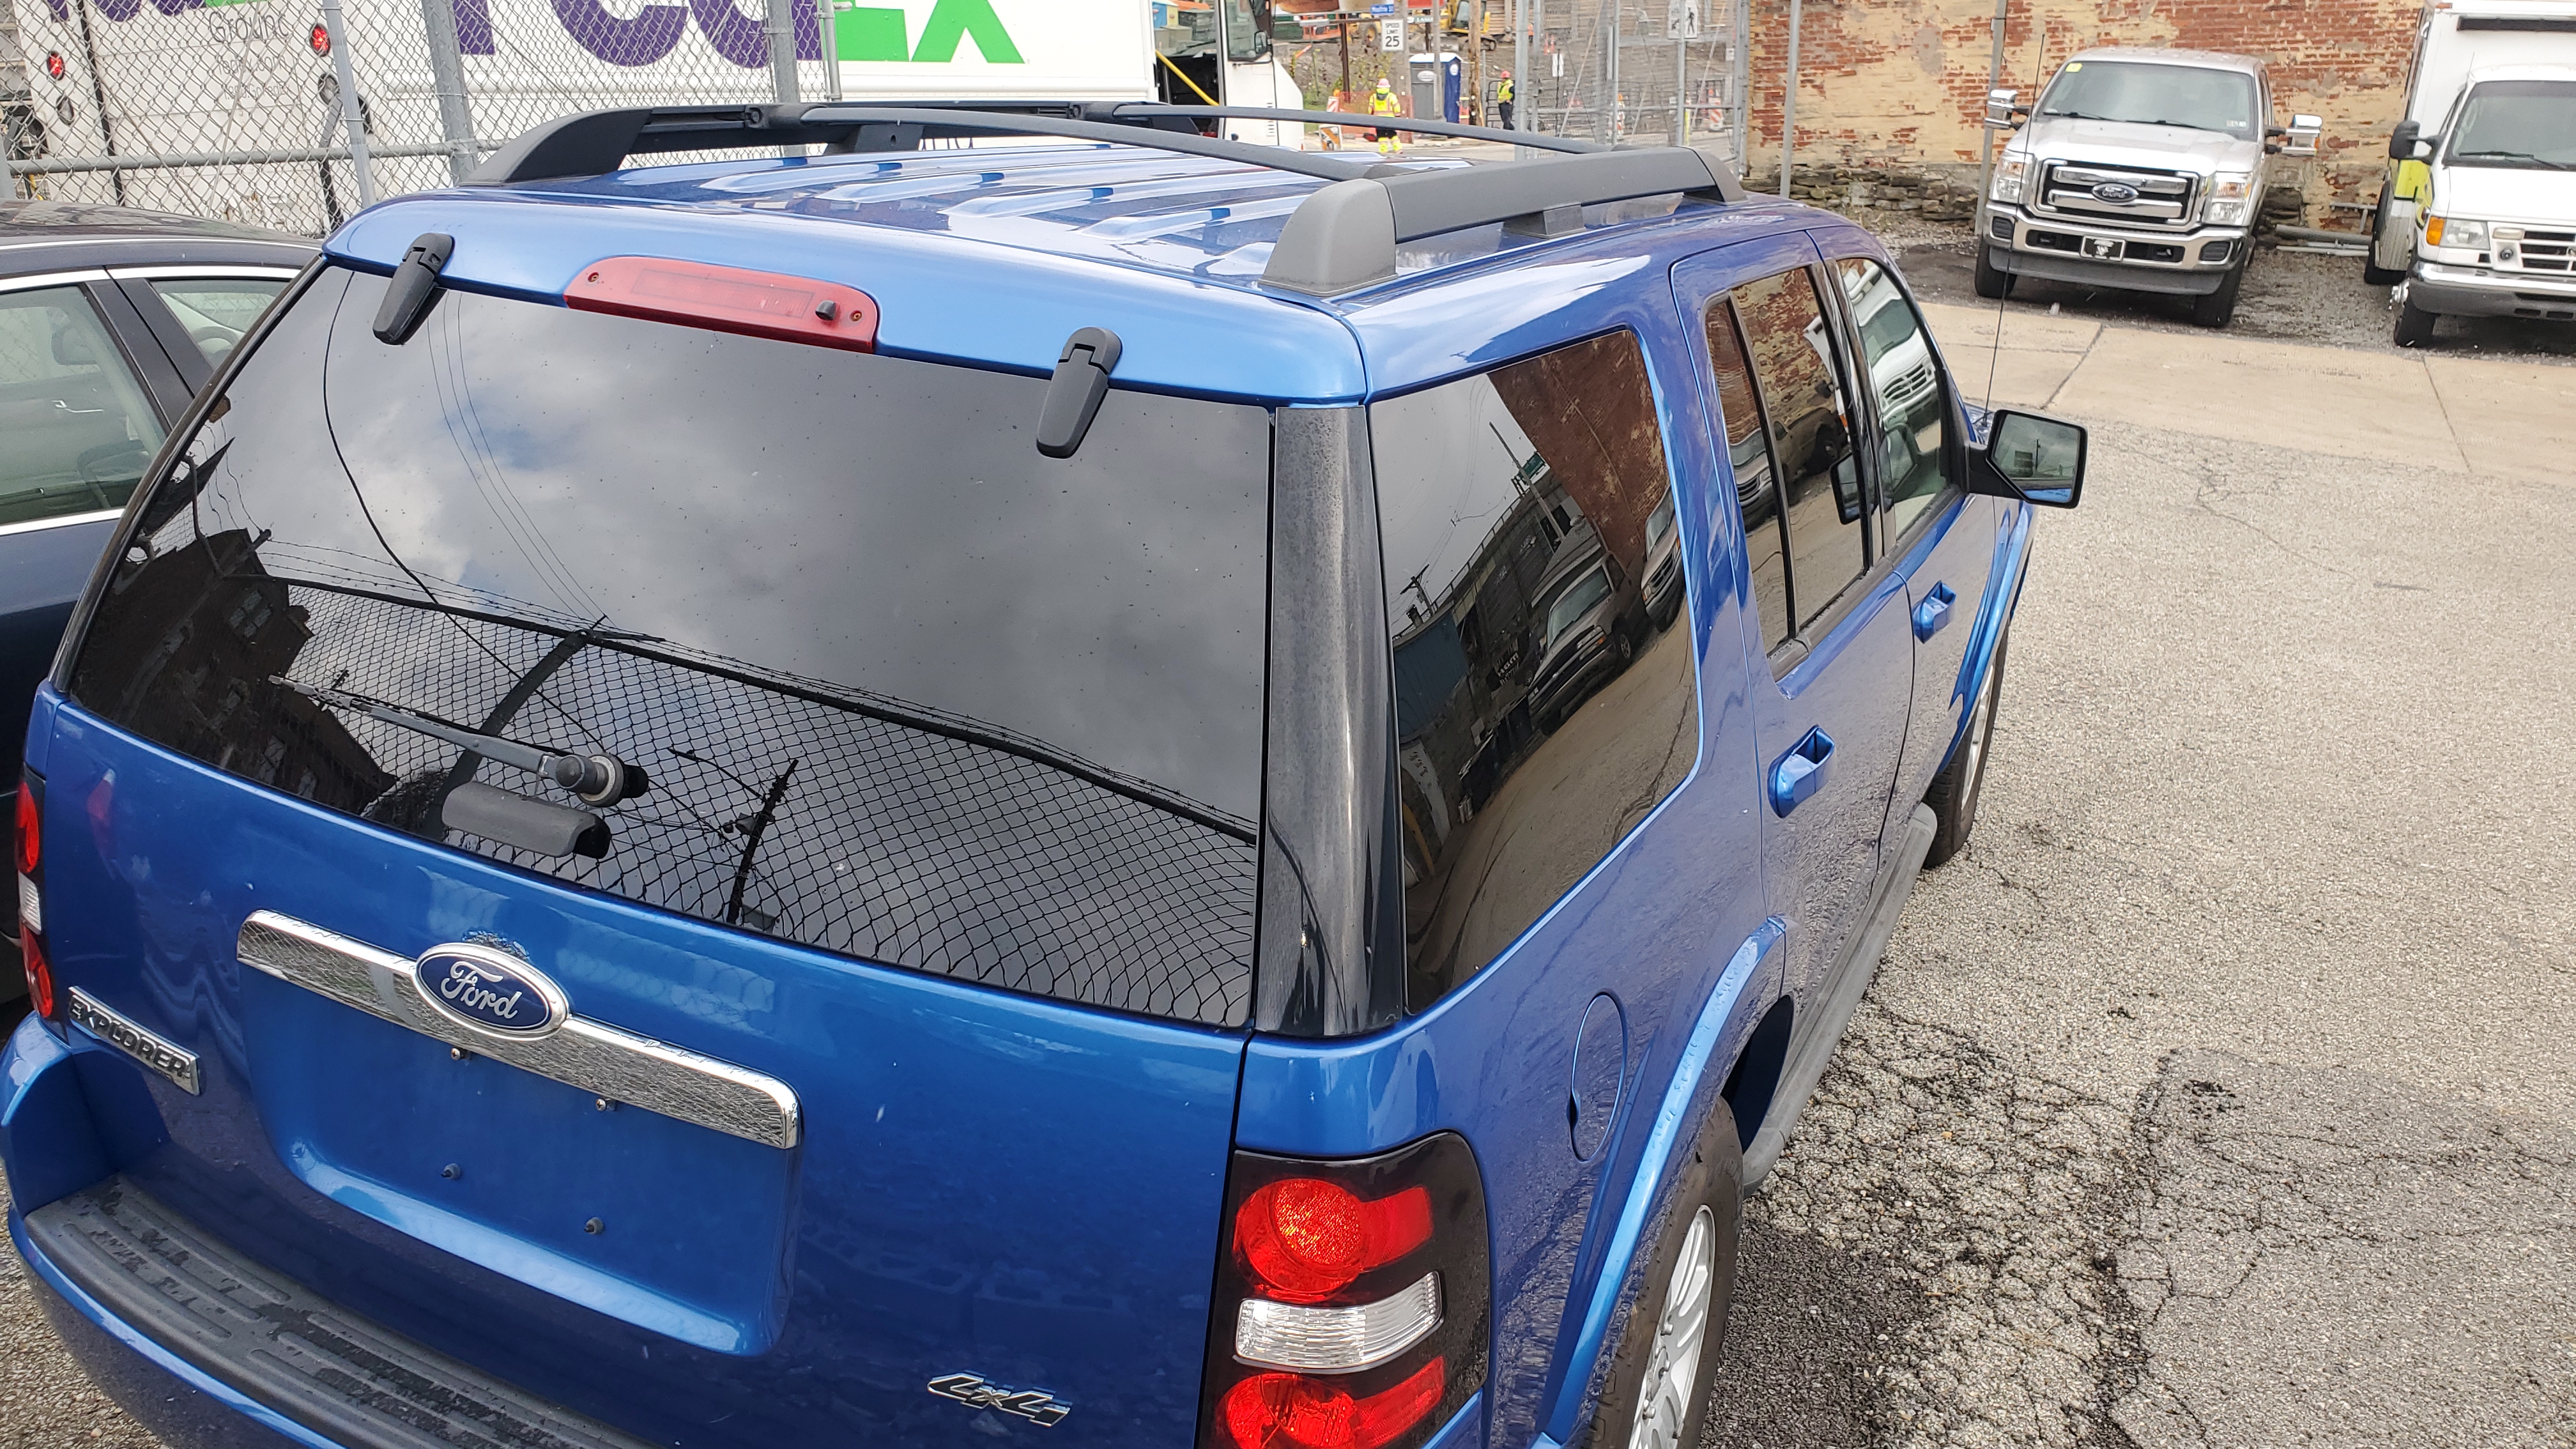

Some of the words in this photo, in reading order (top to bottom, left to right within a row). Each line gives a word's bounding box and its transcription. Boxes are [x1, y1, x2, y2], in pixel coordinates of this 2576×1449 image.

[1385, 35, 1400, 47] 25
[2101, 186, 2128, 199] Ford
[440, 961, 523, 1019] Ford
[68, 994, 190, 1077] EXPLORER
